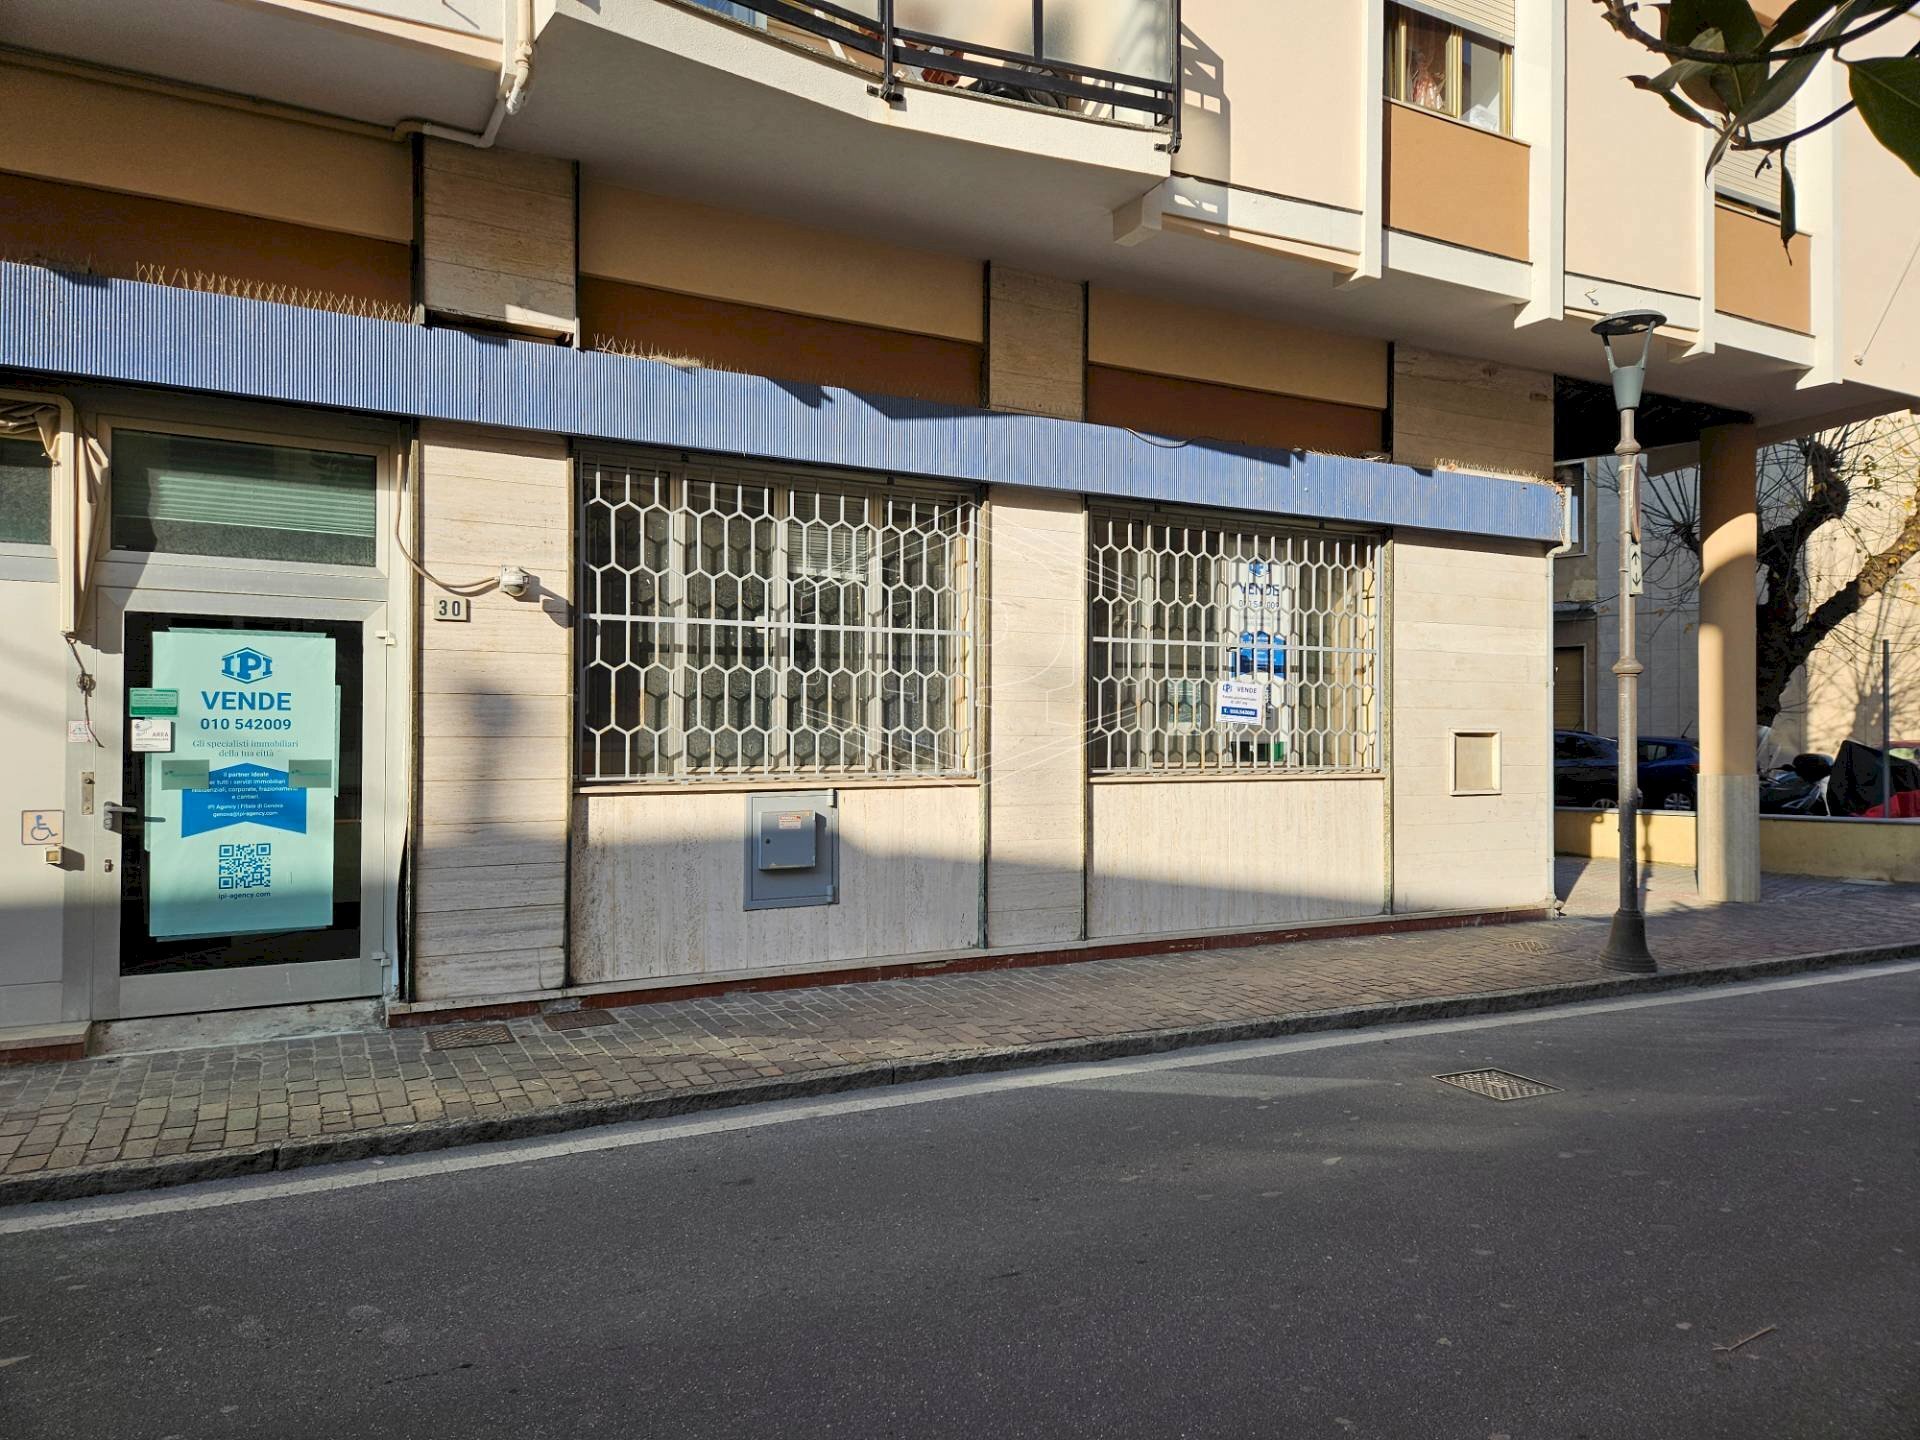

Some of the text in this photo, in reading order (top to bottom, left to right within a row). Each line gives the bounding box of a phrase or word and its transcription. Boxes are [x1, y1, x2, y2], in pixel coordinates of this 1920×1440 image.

[438, 599, 461, 617] 30
[221, 651, 273, 680] IPI
[1236, 686, 1257, 694] VENDE
[201, 691, 292, 711] VENDE
[200, 718, 292, 730] 010 542009
[192, 739, 299, 750] Gli specialisti immobiliari
[219, 749, 274, 758] della tua città
[218, 891, 271, 900] ipi-agency.com
